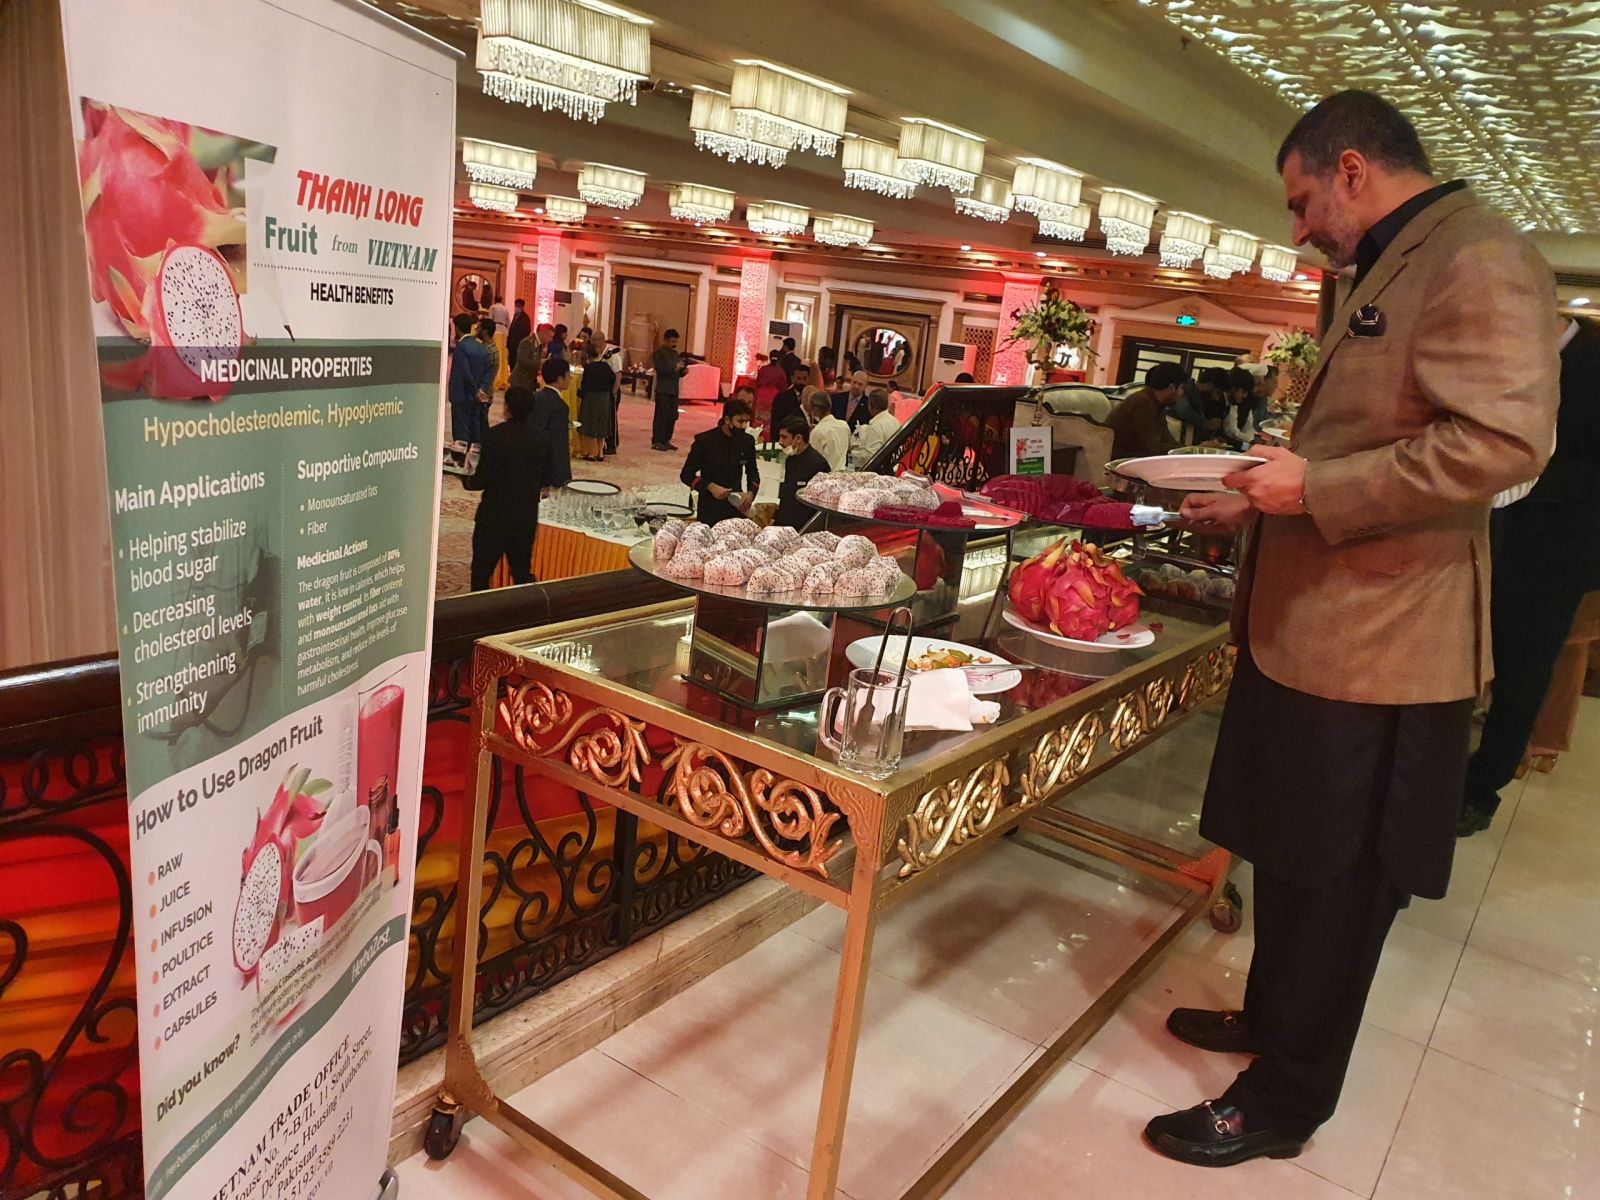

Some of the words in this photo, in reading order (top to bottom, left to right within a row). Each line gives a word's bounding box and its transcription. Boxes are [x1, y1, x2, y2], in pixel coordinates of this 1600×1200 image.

[296, 169, 372, 221] THANH
[374, 188, 424, 228] LONG
[264, 216, 318, 255] Fruit
[331, 234, 358, 254] from
[368, 238, 438, 273] VIETNAM
[310, 282, 354, 304] HEALTH
[354, 283, 394, 306] BENEFITS
[200, 356, 289, 383] MEDICINAL
[291, 356, 372, 379] PROPERTIES
[144, 404, 324, 448] Hypocholesterolemic,
[328, 396, 404, 428] Hypoglycemic
[298, 452, 361, 482] Supportive
[362, 442, 418, 469] Compounds
[114, 484, 155, 514] Main
[160, 470, 265, 509] Applications
[308, 487, 368, 512] Monounsaturated
[129, 531, 187, 562] Helping
[191, 518, 246, 548] stabilize
[308, 521, 328, 536] Fiber
[130, 560, 172, 592] blood
[176, 554, 219, 582] sugar
[297, 546, 342, 570] Medicinal
[343, 540, 368, 558] Actions
[298, 580, 312, 594] The
[314, 574, 338, 590] dragon
[298, 595, 324, 612] water,
[338, 586, 348, 599] low
[388, 563, 406, 576] helps
[132, 594, 216, 634] Decreasing
[134, 617, 216, 664] cholesterol
[218, 606, 252, 636] levels
[298, 613, 314, 628] with
[316, 604, 342, 622] weight
[297, 631, 350, 666] gastrointestinal
[298, 630, 312, 646] and
[136, 652, 236, 704] Strengthening
[297, 654, 340, 680] metabolism,
[297, 676, 326, 696] harmful
[138, 690, 208, 734] immunity
[136, 798, 174, 840] How
[178, 788, 198, 812] to
[202, 770, 236, 799] Use
[239, 736, 287, 782] Dragon
[290, 715, 323, 749] Fruit
[158, 853, 183, 880] RAW
[160, 881, 191, 912] JUICE
[160, 901, 212, 946] INFUSION
[162, 931, 214, 978] POULTICE
[162, 964, 211, 1011] EXTRACT
[164, 991, 218, 1042] CAPSULES
[157, 1089, 176, 1122] Did
[177, 1072, 202, 1106] you
[204, 1033, 240, 1078] know?
[268, 1083, 311, 1141] TRADE
[314, 1034, 350, 1089] OFFICE
[262, 1143, 299, 1199] Defence
[302, 1095, 338, 1146] Housing
[277, 1144, 318, 1198] Pakistan
